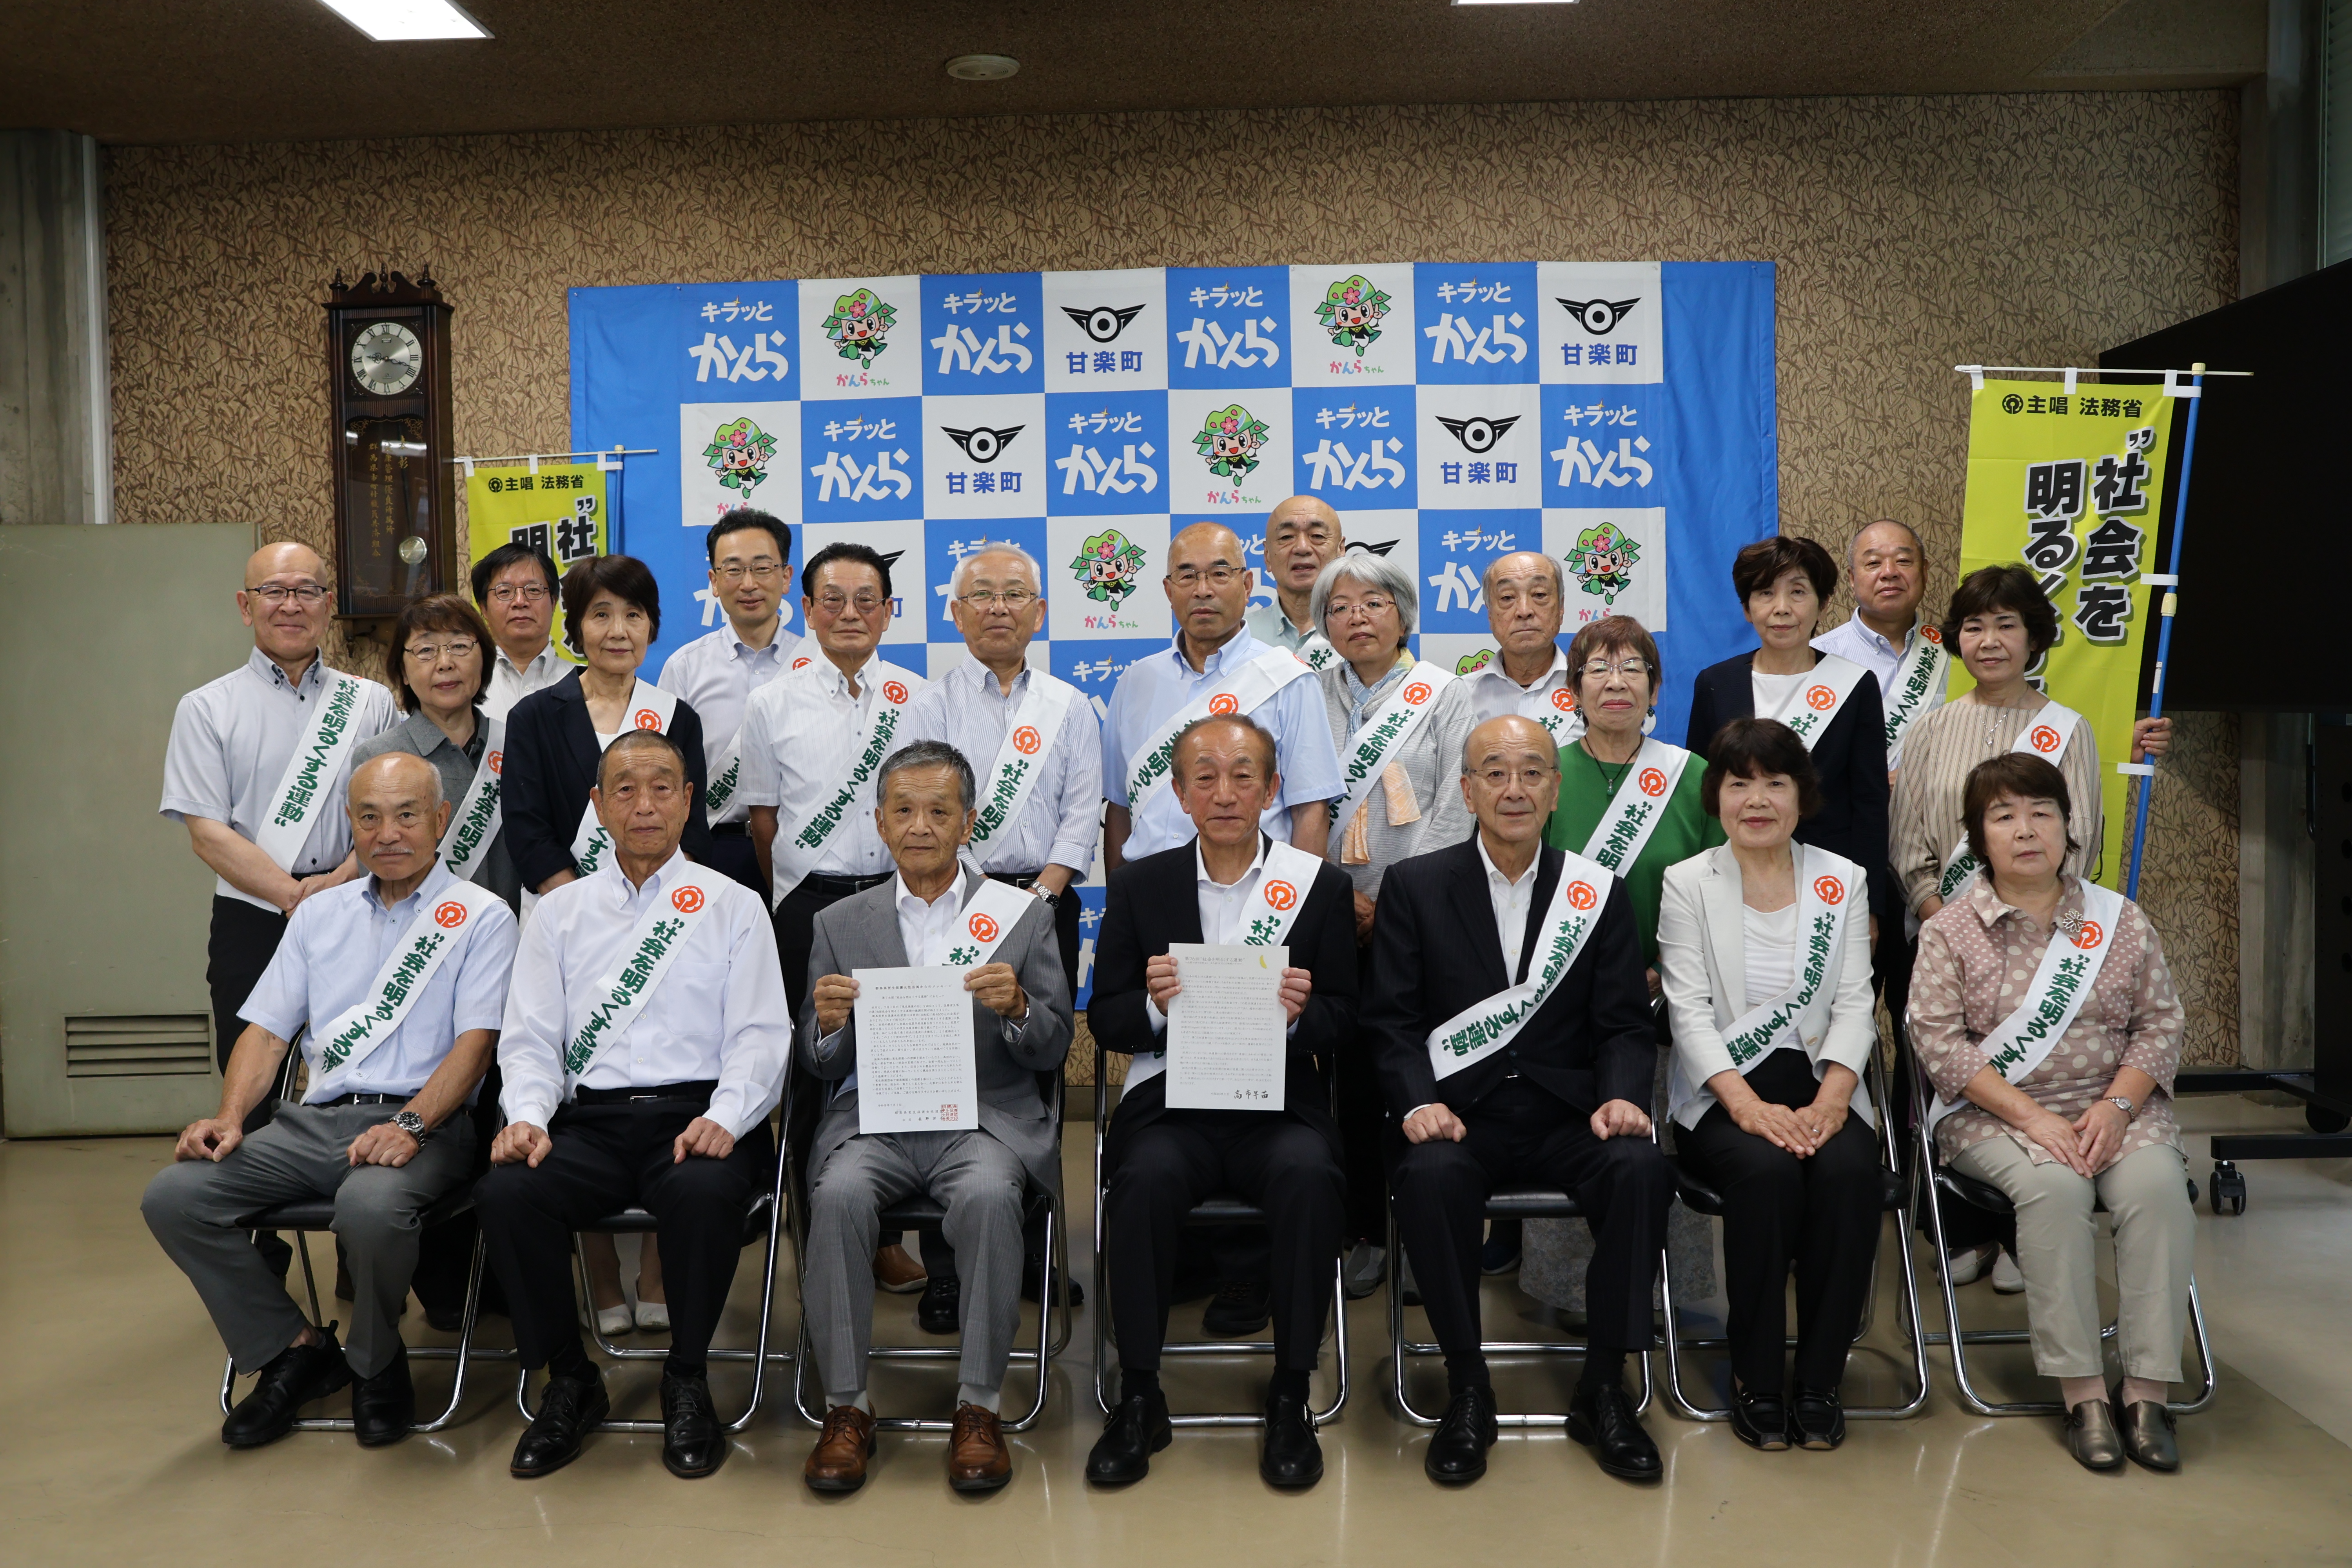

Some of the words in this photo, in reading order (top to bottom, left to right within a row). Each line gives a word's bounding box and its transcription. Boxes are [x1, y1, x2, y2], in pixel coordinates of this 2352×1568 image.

[944, 293, 1016, 314] キラッと
[1189, 286, 1263, 308] キラッと
[1437, 281, 1511, 304] キラッと
[701, 299, 773, 323] キラッと
[931, 323, 1032, 375] かんら
[1176, 317, 1279, 369] かんら
[1424, 312, 1527, 365] かんら
[689, 330, 788, 383] かんら
[1067, 351, 1142, 374] 甘楽町
[1562, 344, 1637, 365] 甘楽町
[1330, 360, 1383, 374] かんらちゃん
[837, 373, 889, 387] かんらちゃん
[1316, 406, 1390, 430] キラッと
[1564, 404, 1637, 426] キラッと
[2027, 395, 2068, 415] 主唱
[2079, 397, 2143, 418] 法務省
[824, 418, 896, 442] キラッと
[1068, 411, 1142, 434] キラッと
[1055, 442, 1157, 495] かんら
[1303, 437, 1405, 490] かんら
[1441, 462, 1517, 483] 甘楽町
[1550, 436, 1653, 488] かんら
[505, 477, 534, 491] 主唱
[541, 474, 584, 490] 法務省
[811, 448, 911, 502] かんら
[946, 472, 1022, 494] 甘楽町
[1207, 490, 1261, 504] かんらちゃん
[1442, 530, 1516, 552] キラッと
[1085, 615, 1138, 629] かんらちゃん
[1073, 660, 1137, 682] キラッ
